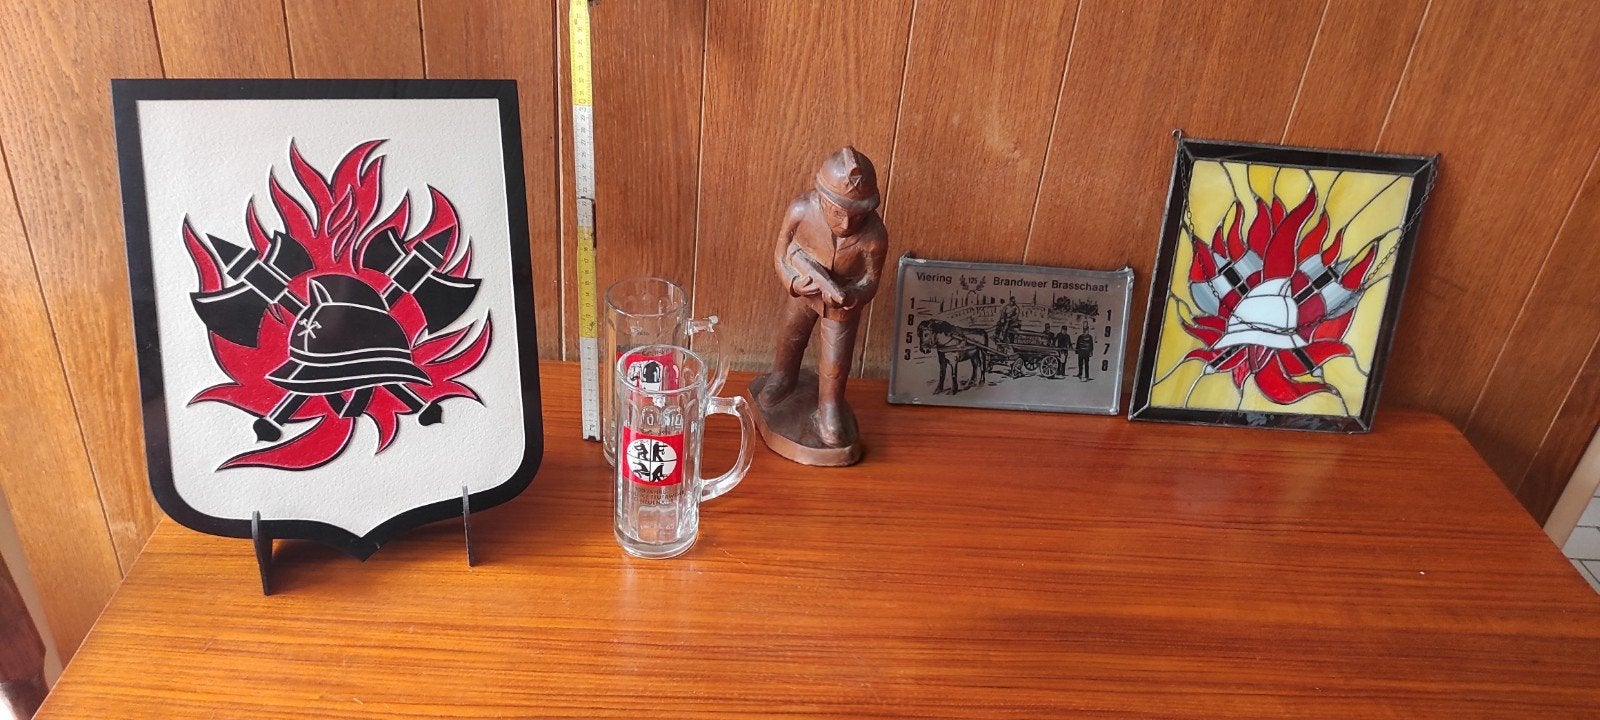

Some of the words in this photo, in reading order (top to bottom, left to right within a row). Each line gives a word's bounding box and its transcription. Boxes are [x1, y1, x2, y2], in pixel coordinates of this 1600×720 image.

[916, 271, 953, 284] Viering
[993, 276, 1047, 289] Brandweer
[1052, 279, 1109, 292] Brasschaat
